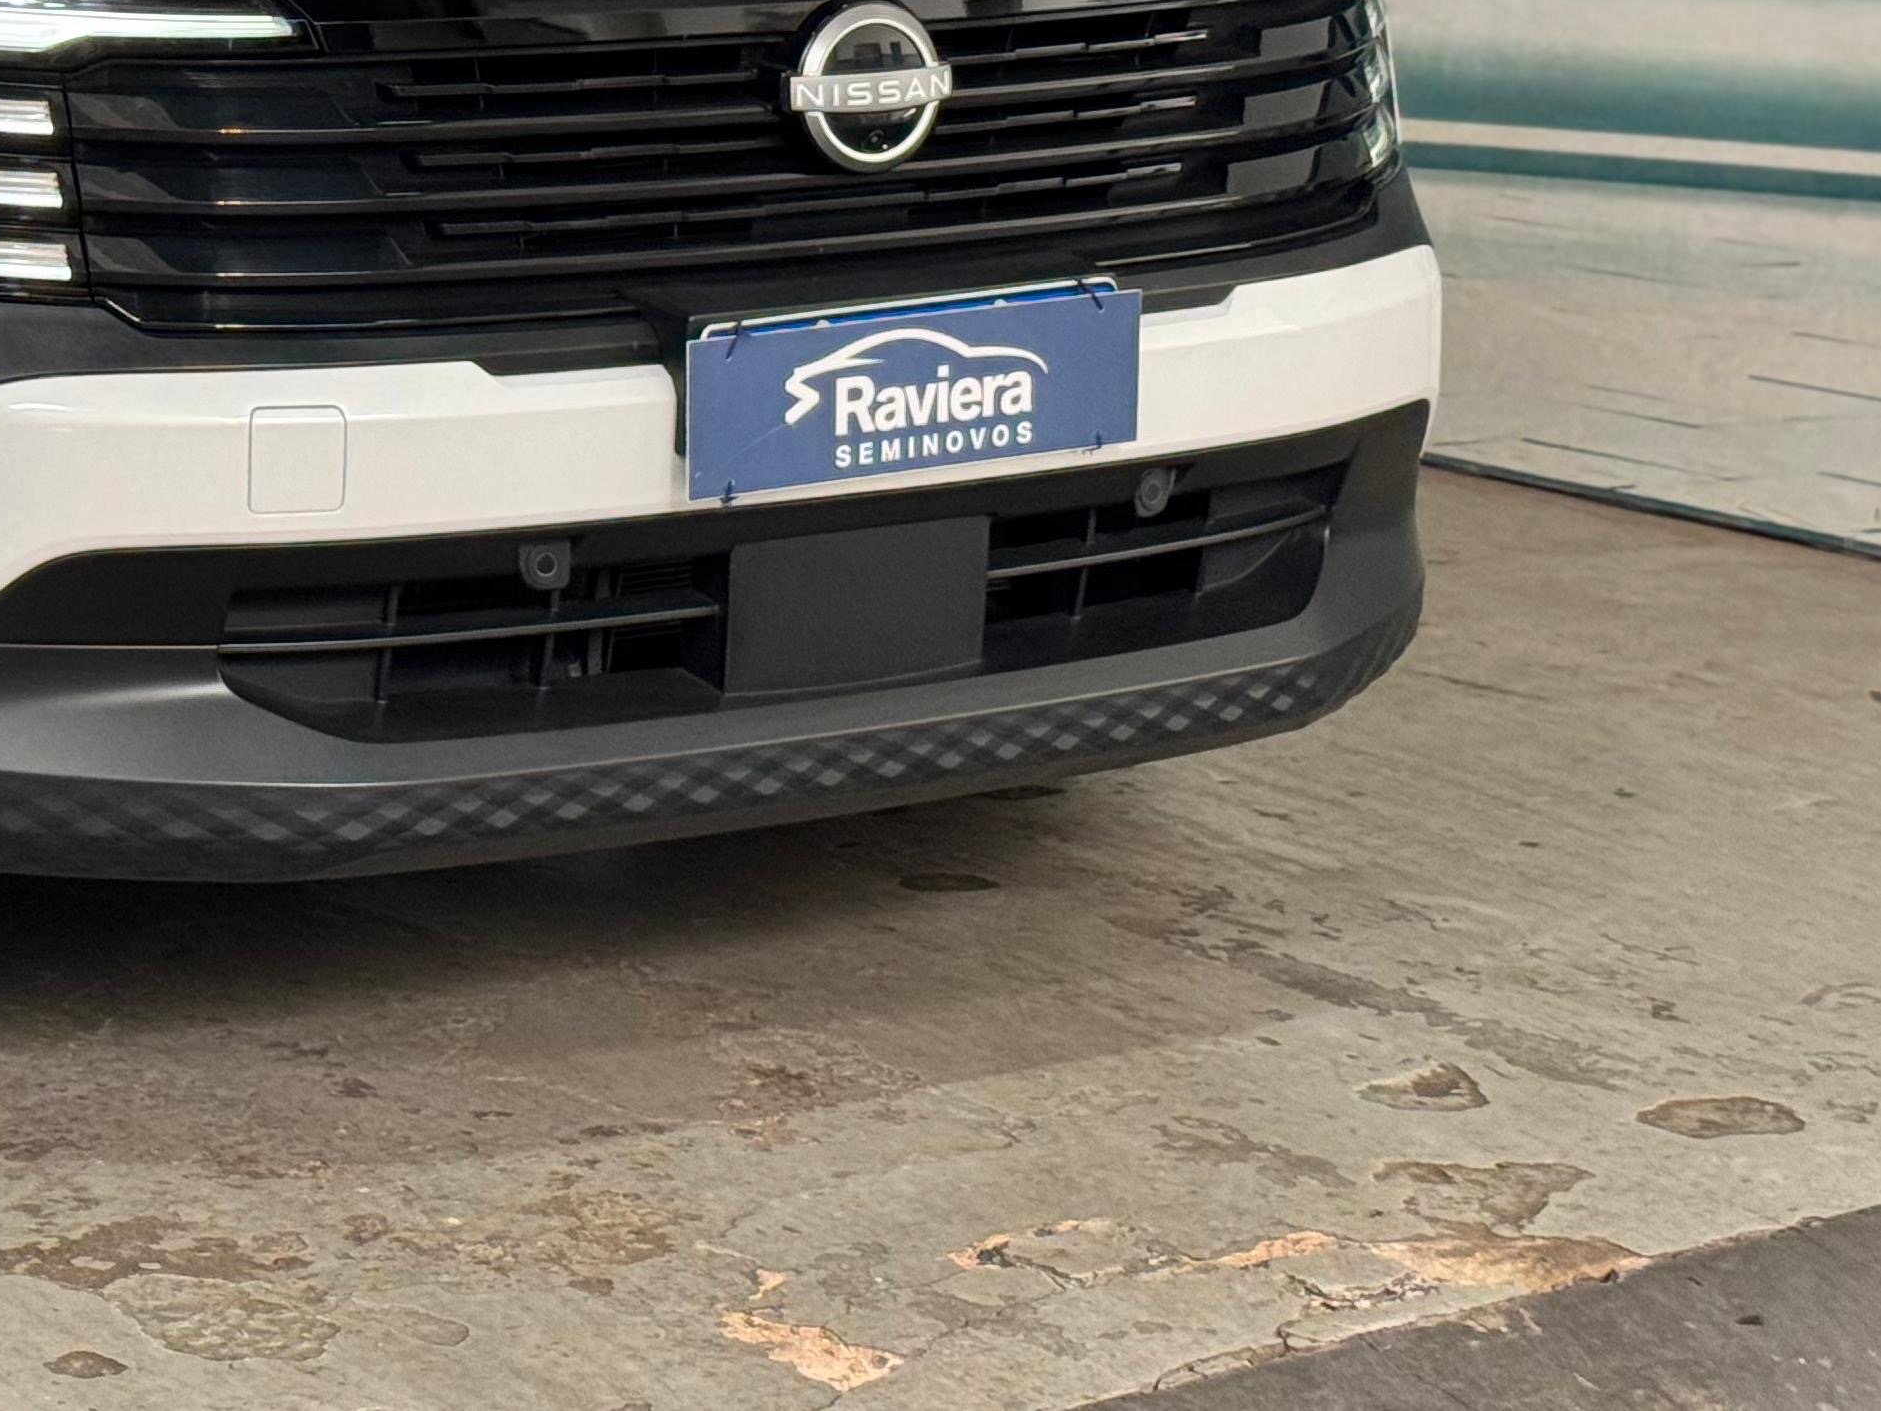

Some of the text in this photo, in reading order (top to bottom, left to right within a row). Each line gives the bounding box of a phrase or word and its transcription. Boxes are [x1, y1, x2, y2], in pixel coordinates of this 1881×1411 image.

[794, 69, 952, 108] NISSAN
[834, 364, 1034, 438] Raviera
[833, 419, 1035, 470] SEMINOVOS
